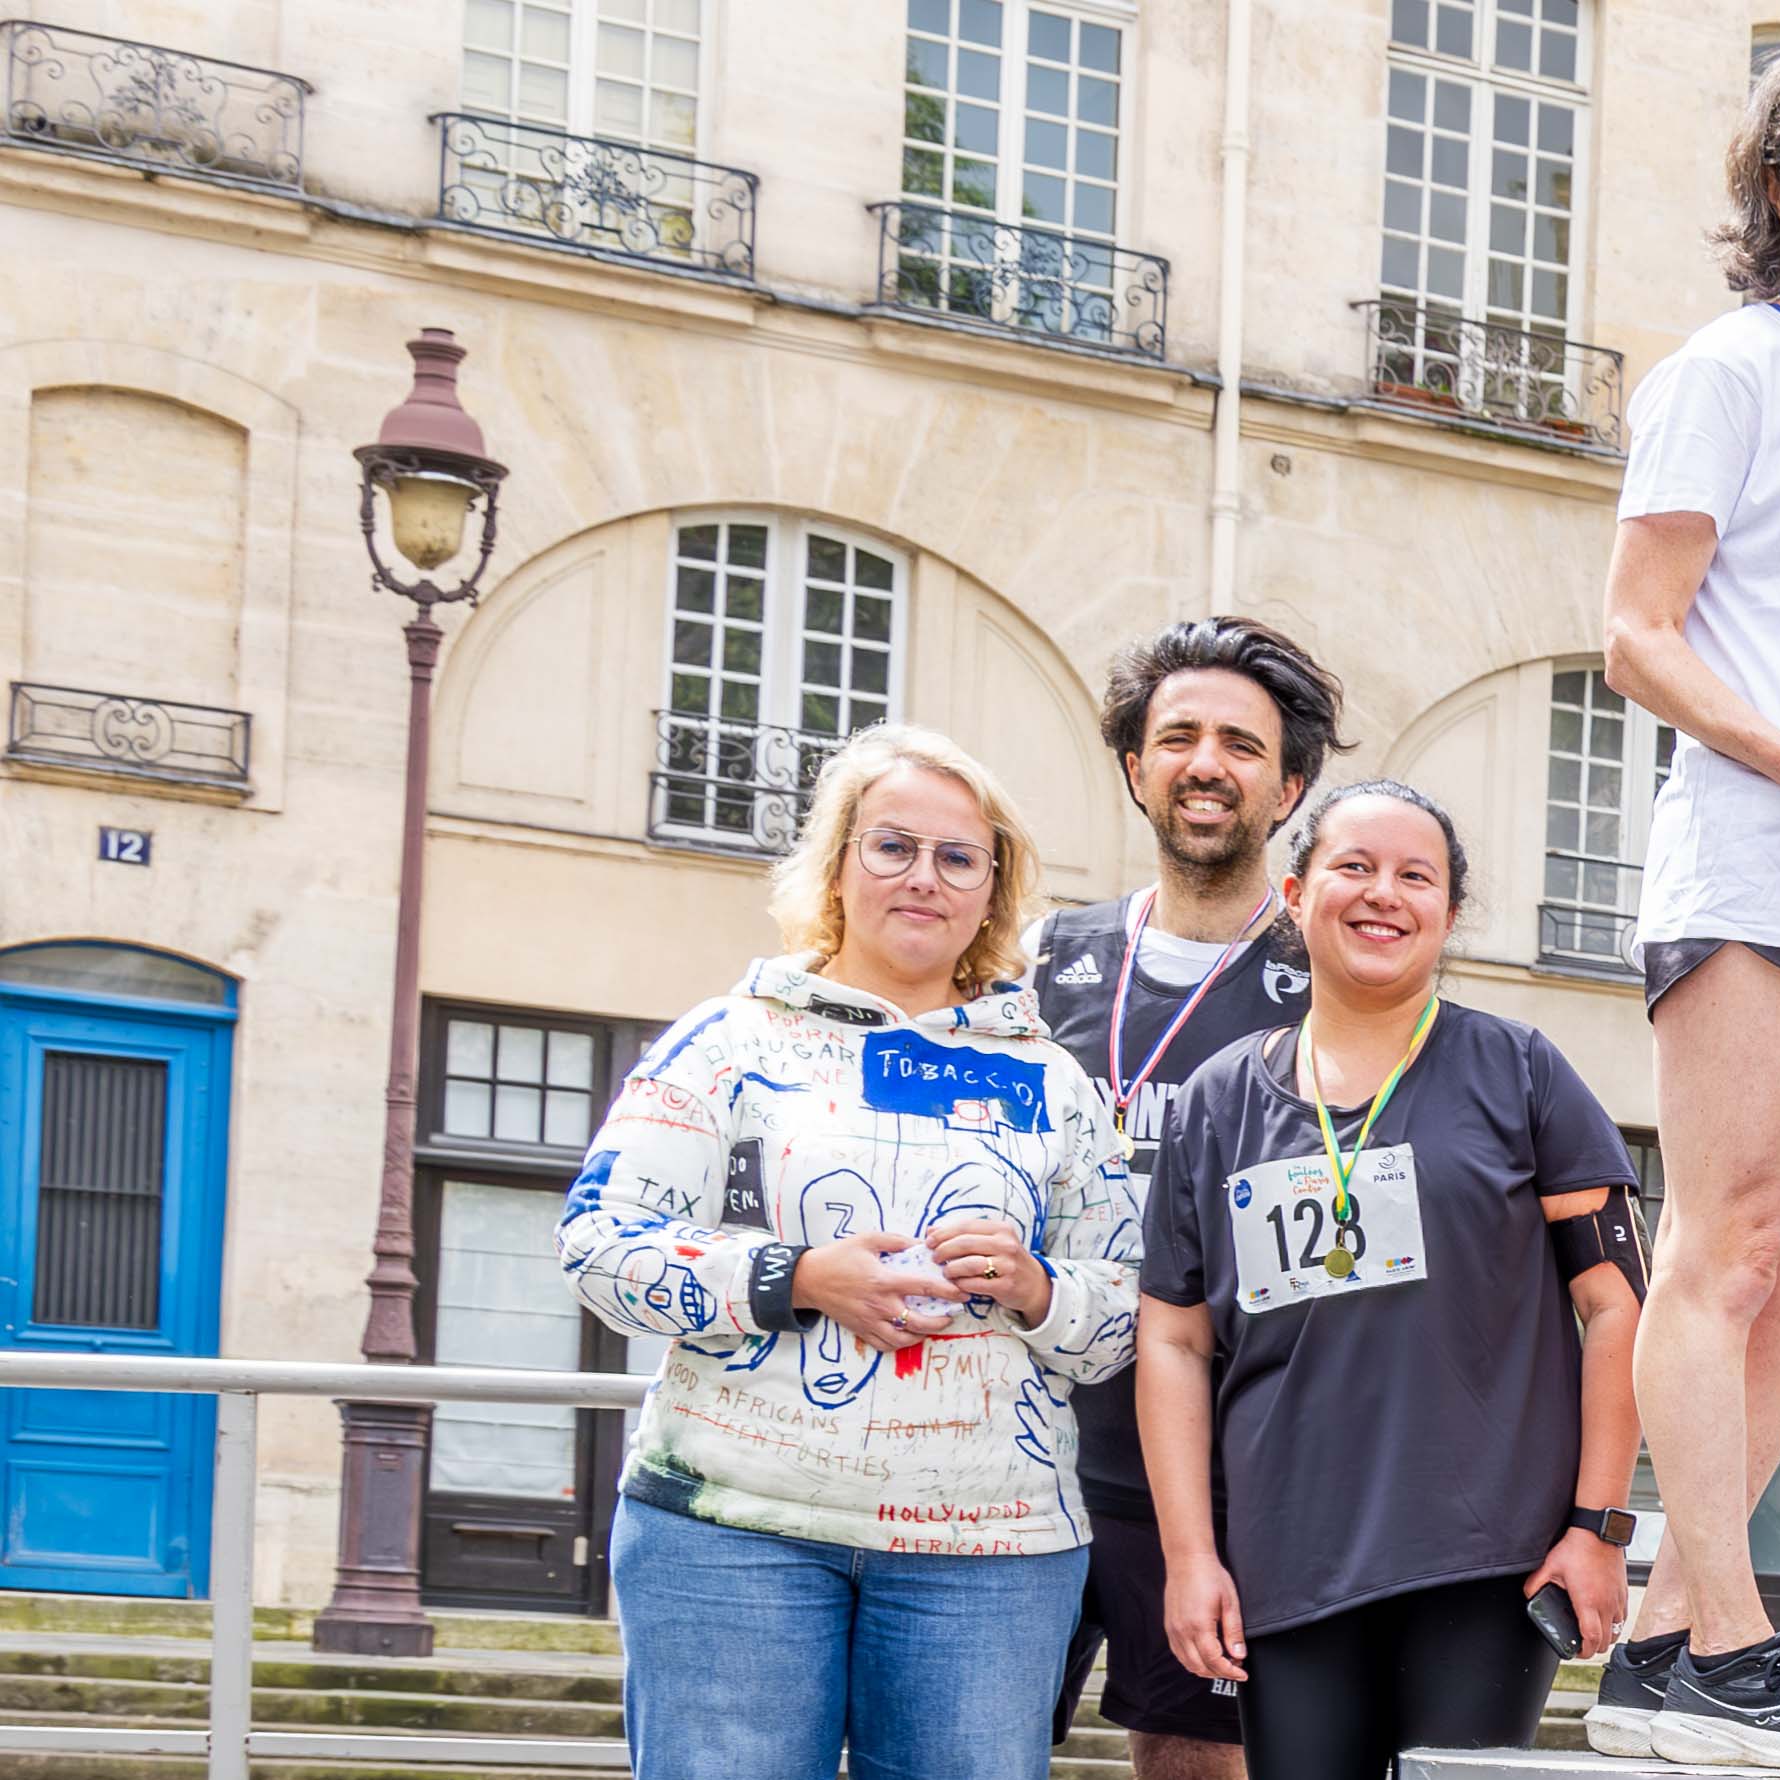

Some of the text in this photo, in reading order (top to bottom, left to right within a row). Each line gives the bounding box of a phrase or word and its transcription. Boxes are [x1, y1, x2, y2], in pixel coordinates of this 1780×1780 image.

[107, 831, 144, 862] 12
[1055, 973, 1103, 985] adidas
[876, 1048, 1035, 1107] TOBACCO
[1373, 1171, 1406, 1184] PARIS
[637, 1176, 702, 1219] TAX
[716, 1384, 841, 1435] AFRICANS
[878, 1499, 1032, 1523] HOLLYWOOD
